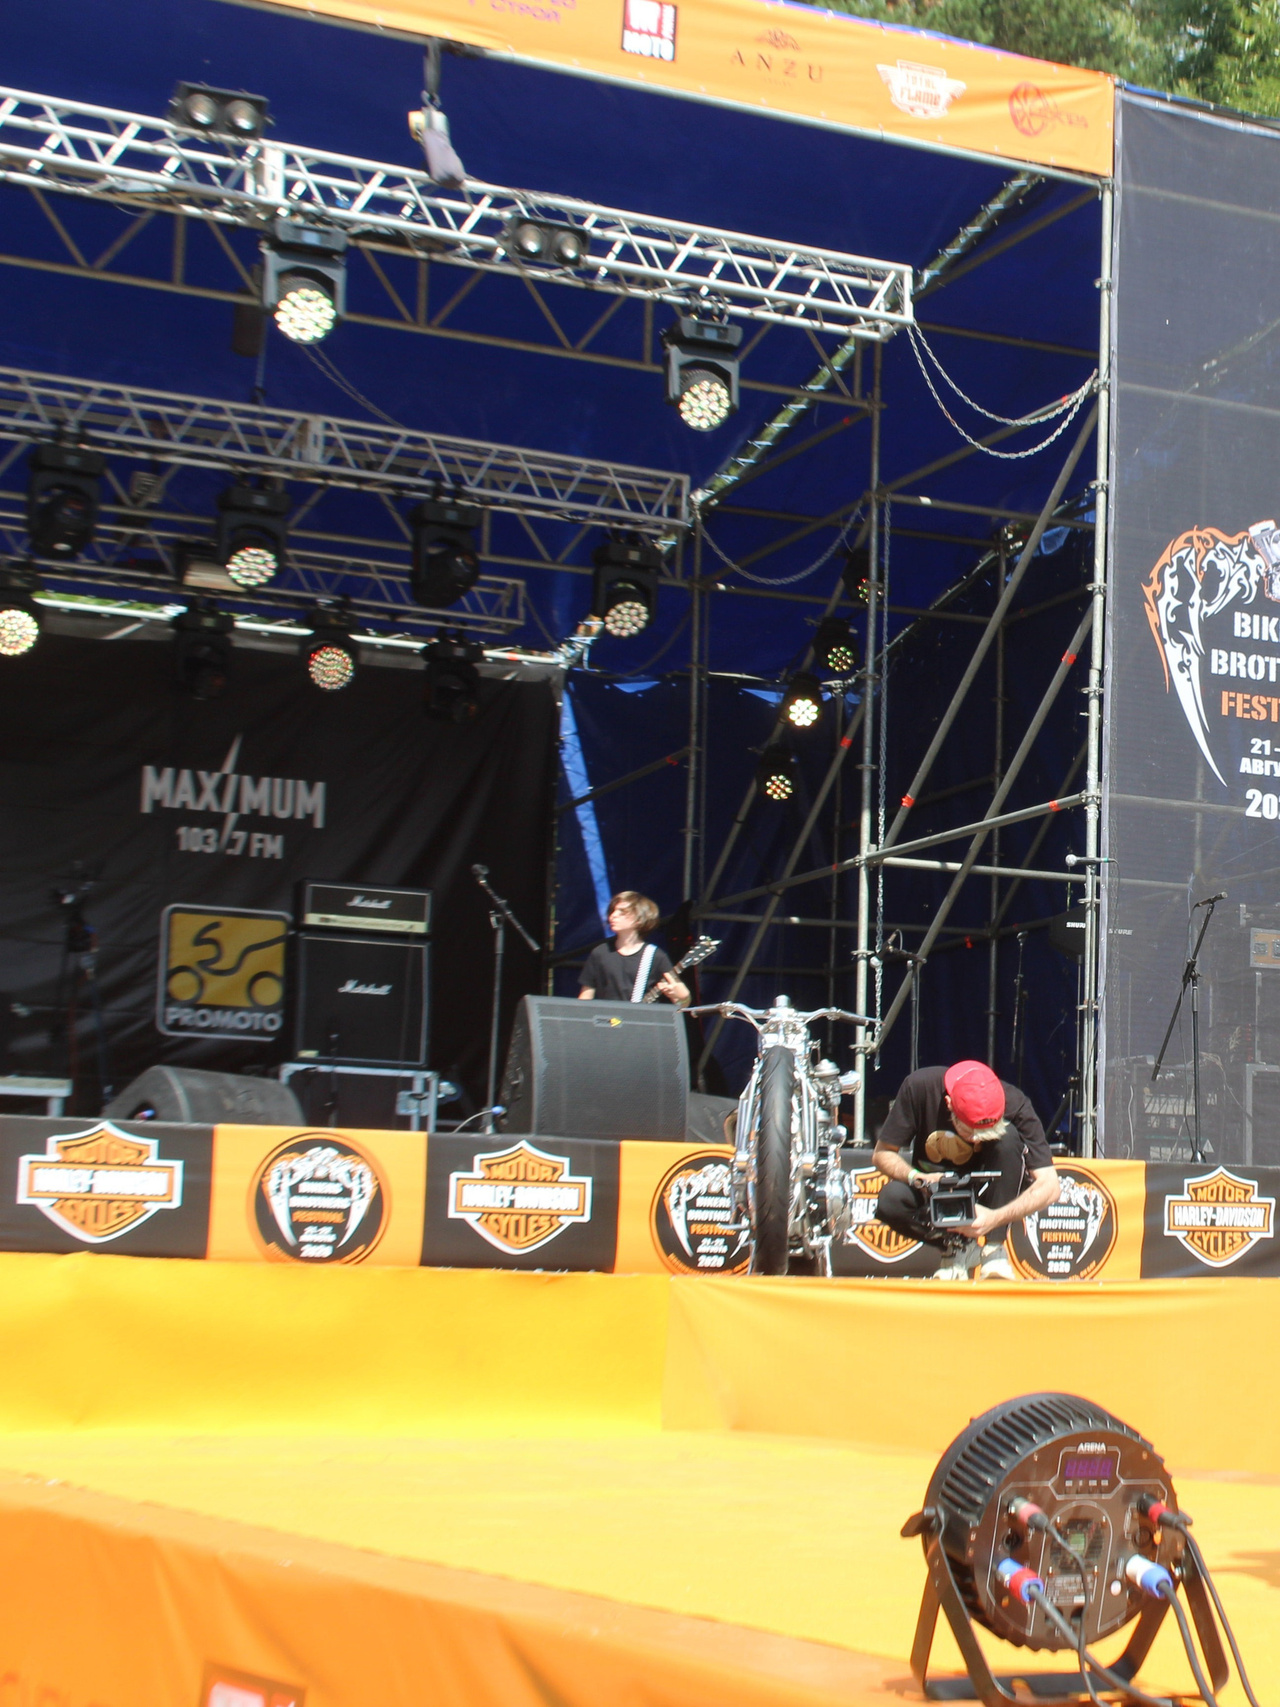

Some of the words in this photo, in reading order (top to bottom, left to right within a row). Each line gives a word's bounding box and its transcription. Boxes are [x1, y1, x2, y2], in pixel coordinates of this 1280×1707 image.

[731, 49, 823, 82] ANZU
[250, 831, 284, 860] FM
[164, 1006, 283, 1032] PROMOTO
[490, 1157, 555, 1182] MOTOR
[1197, 1180, 1245, 1202] MOTOR
[486, 1214, 551, 1240] CYCLES
[1174, 1205, 1265, 1228] HARLEY-DAVIDSON
[1194, 1231, 1243, 1257] CYCLES
[1077, 1442, 1106, 1451] ARENA
